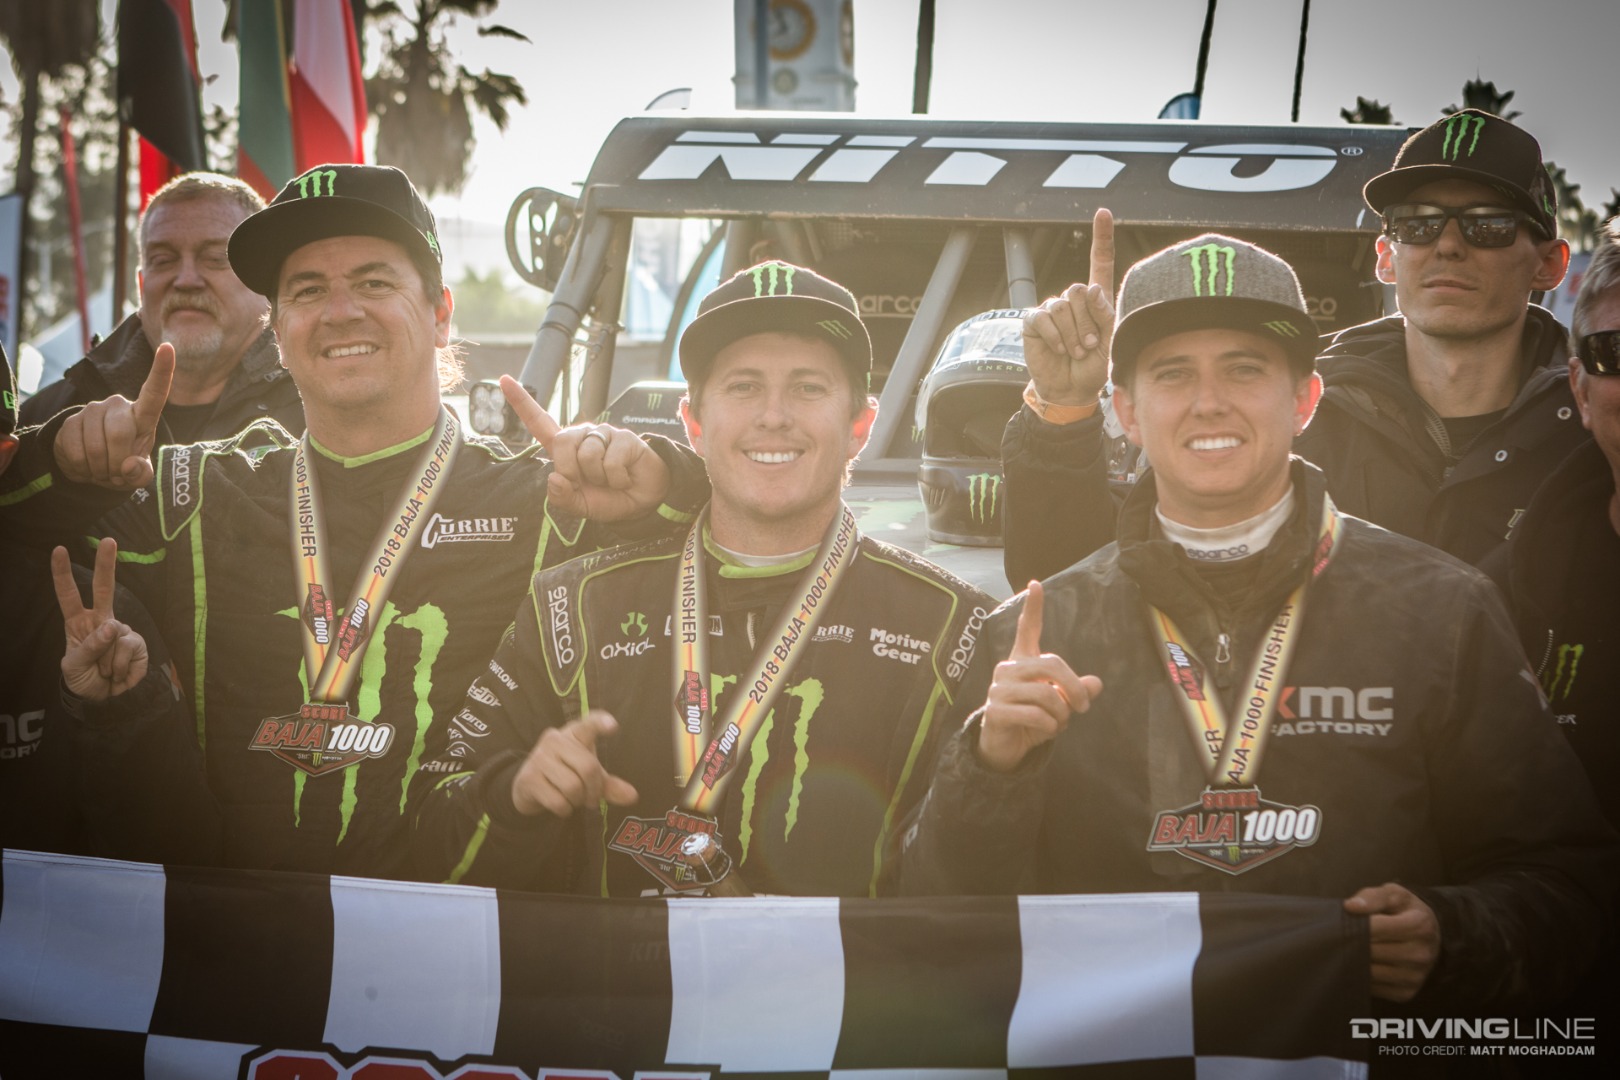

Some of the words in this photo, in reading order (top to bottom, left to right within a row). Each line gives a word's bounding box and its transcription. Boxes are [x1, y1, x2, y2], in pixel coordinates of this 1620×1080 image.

[637, 130, 1338, 193] NITTO
[976, 363, 1024, 373] ENERG
[373, 538, 401, 578] 2018
[394, 498, 423, 538] BAJA
[417, 461, 441, 496] 1000
[435, 413, 457, 464] FINISH
[297, 485, 317, 558] FINISHER
[421, 512, 514, 549] CURRIE
[1186, 544, 1250, 561] sparco
[350, 599, 369, 628] 1000
[682, 565, 697, 644] FINISHER
[314, 616, 329, 643] 1000
[548, 585, 575, 667] sparco
[749, 660, 780, 705] 2018
[773, 617, 806, 663] BAJA
[801, 575, 828, 617] 1000
[816, 624, 855, 639] RRIE
[869, 627, 932, 654] Motive
[872, 642, 922, 665] Gear
[945, 606, 988, 682] sparco
[1167, 642, 1190, 668] 1000
[686, 671, 699, 702] BAJA
[300, 704, 348, 721] SCORE
[687, 704, 701, 733] 1000
[255, 720, 325, 748] BAJA
[326, 724, 391, 753] 1000
[1226, 747, 1251, 785] AJA
[1240, 697, 1265, 739] 1000
[702, 753, 725, 788] BAJA
[718, 723, 740, 756] 1000
[1154, 813, 1236, 844] BAJA
[1243, 808, 1318, 842] 1000
